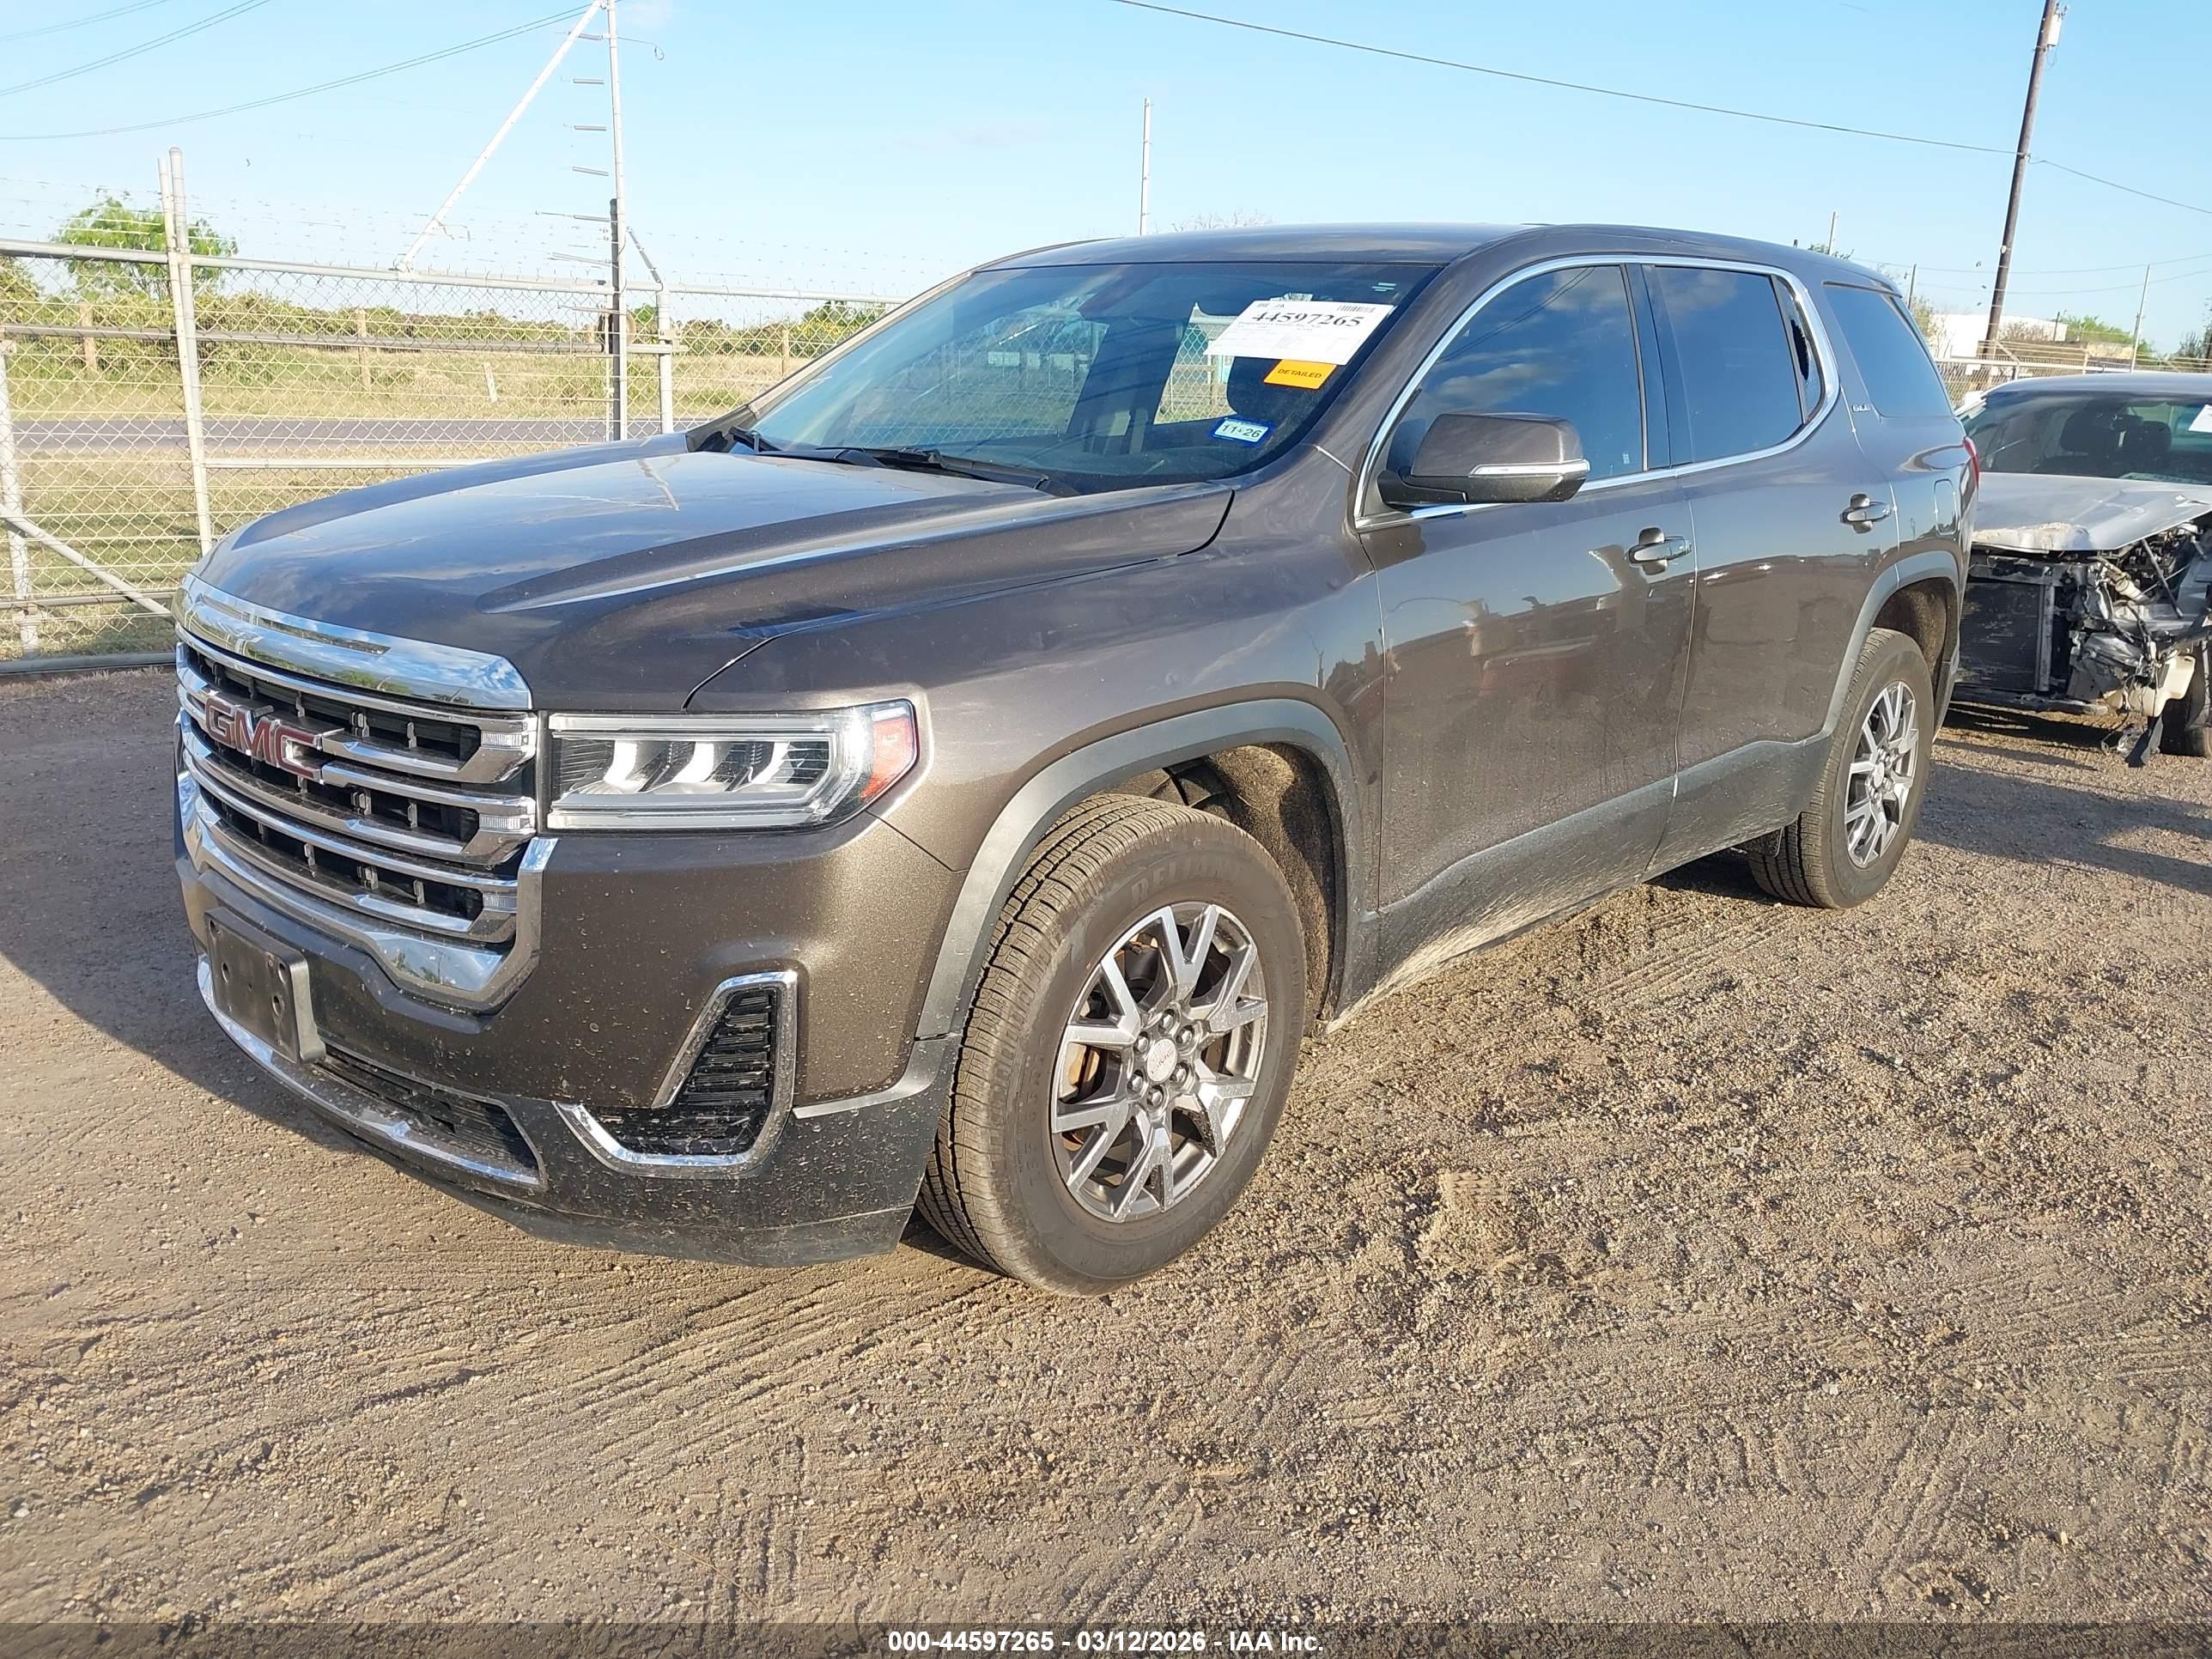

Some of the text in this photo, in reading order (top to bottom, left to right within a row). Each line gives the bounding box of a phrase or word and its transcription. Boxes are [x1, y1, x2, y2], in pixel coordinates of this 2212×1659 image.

[1252, 312, 1364, 327] 44597265
[1278, 368, 1322, 379] DETAILED
[205, 696, 323, 785] GMC
